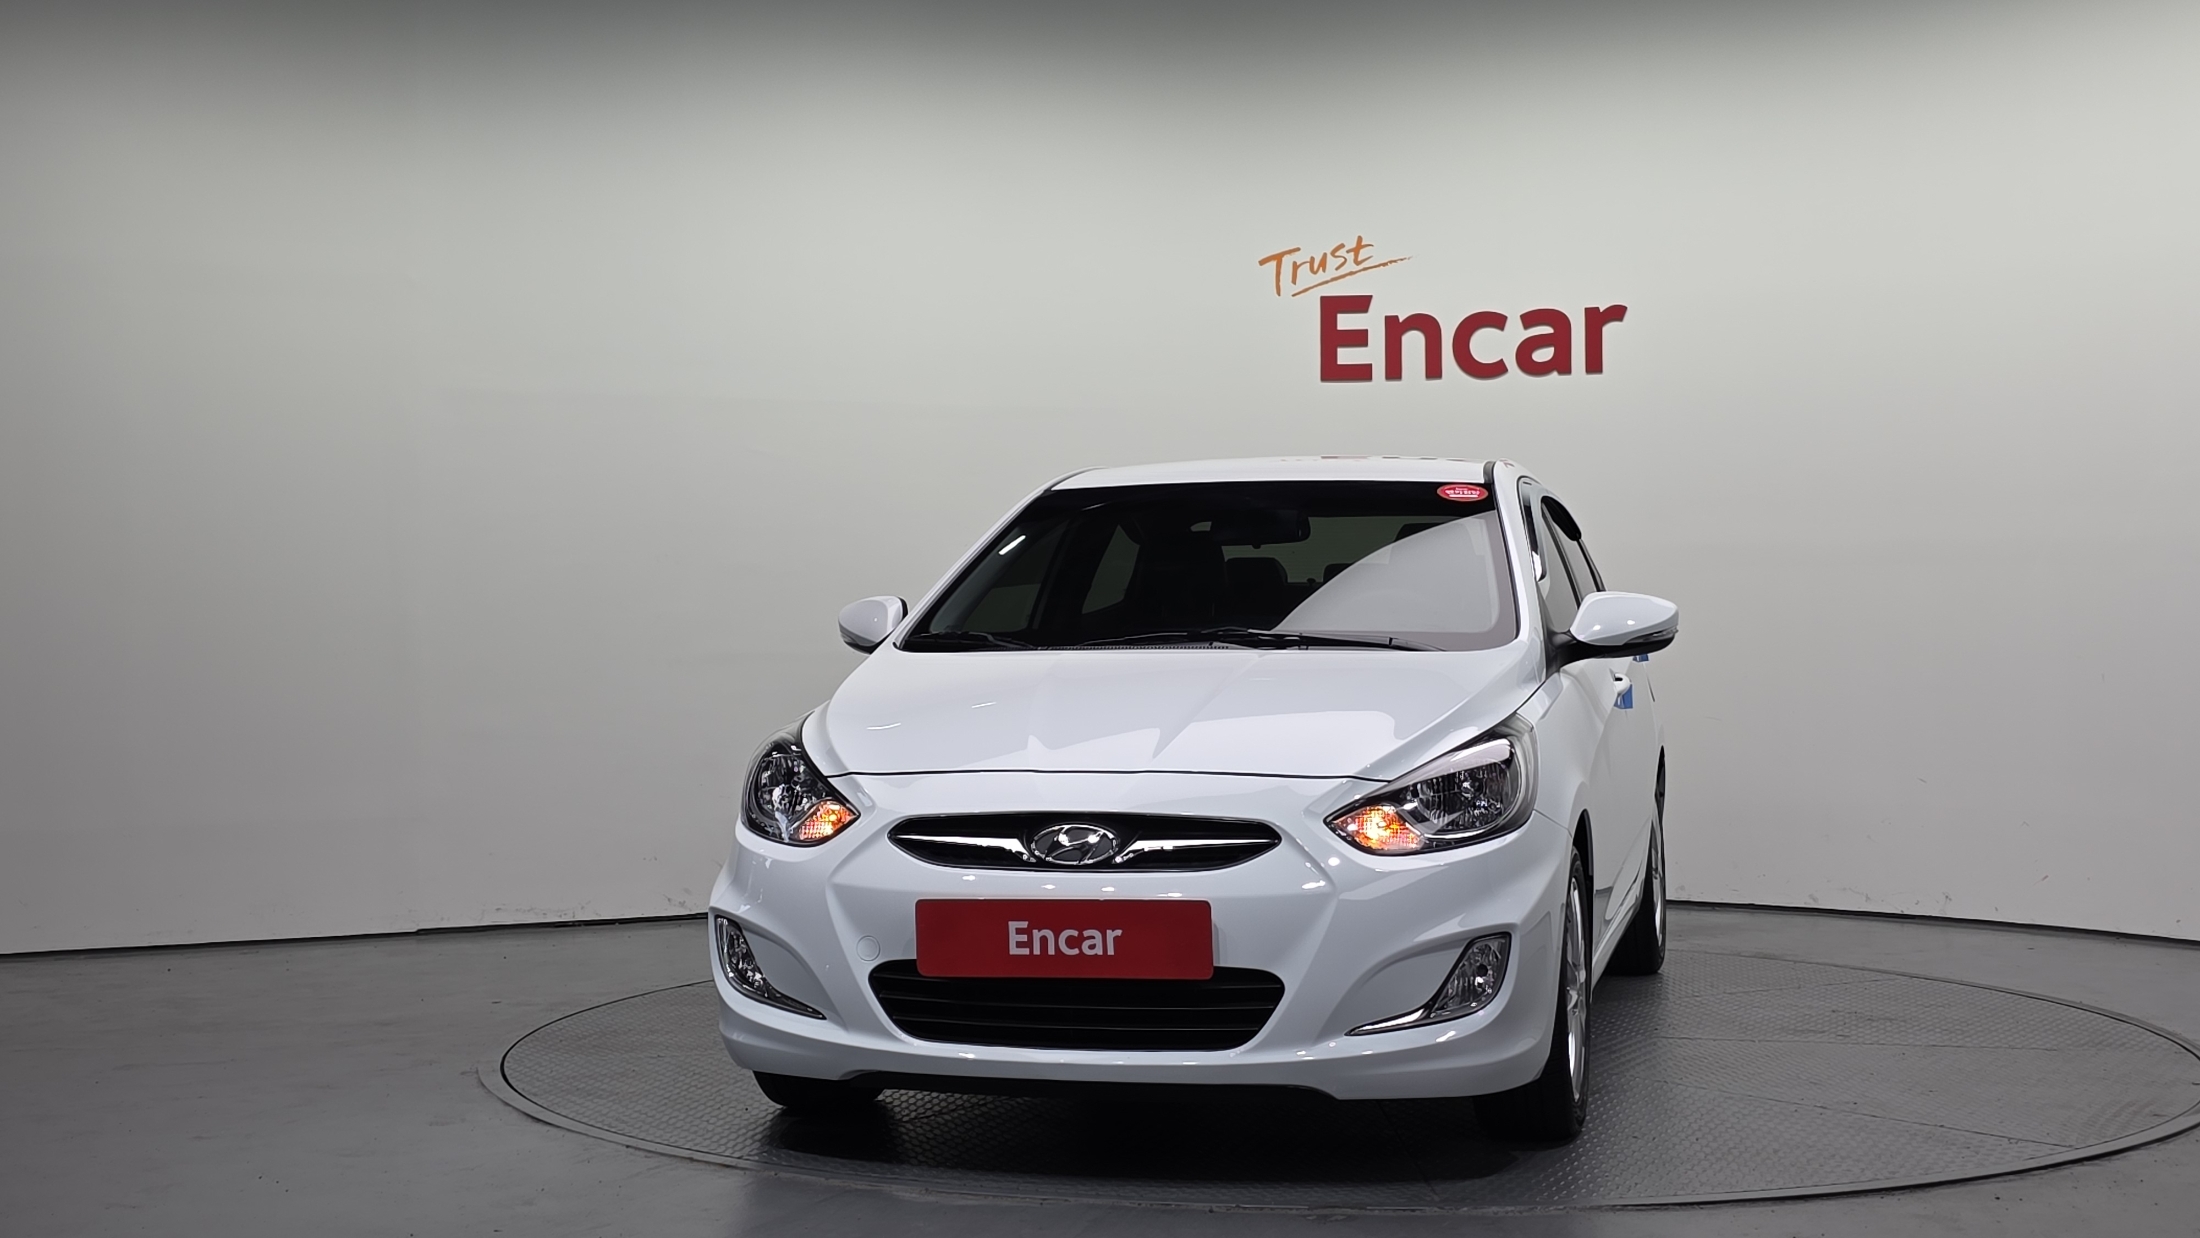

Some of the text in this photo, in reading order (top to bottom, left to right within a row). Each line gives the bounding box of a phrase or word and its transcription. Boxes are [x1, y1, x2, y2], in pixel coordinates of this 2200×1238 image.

[1258, 235, 1375, 297] Trust
[1319, 294, 1628, 382] Encar
[1008, 921, 1123, 956] Encar
